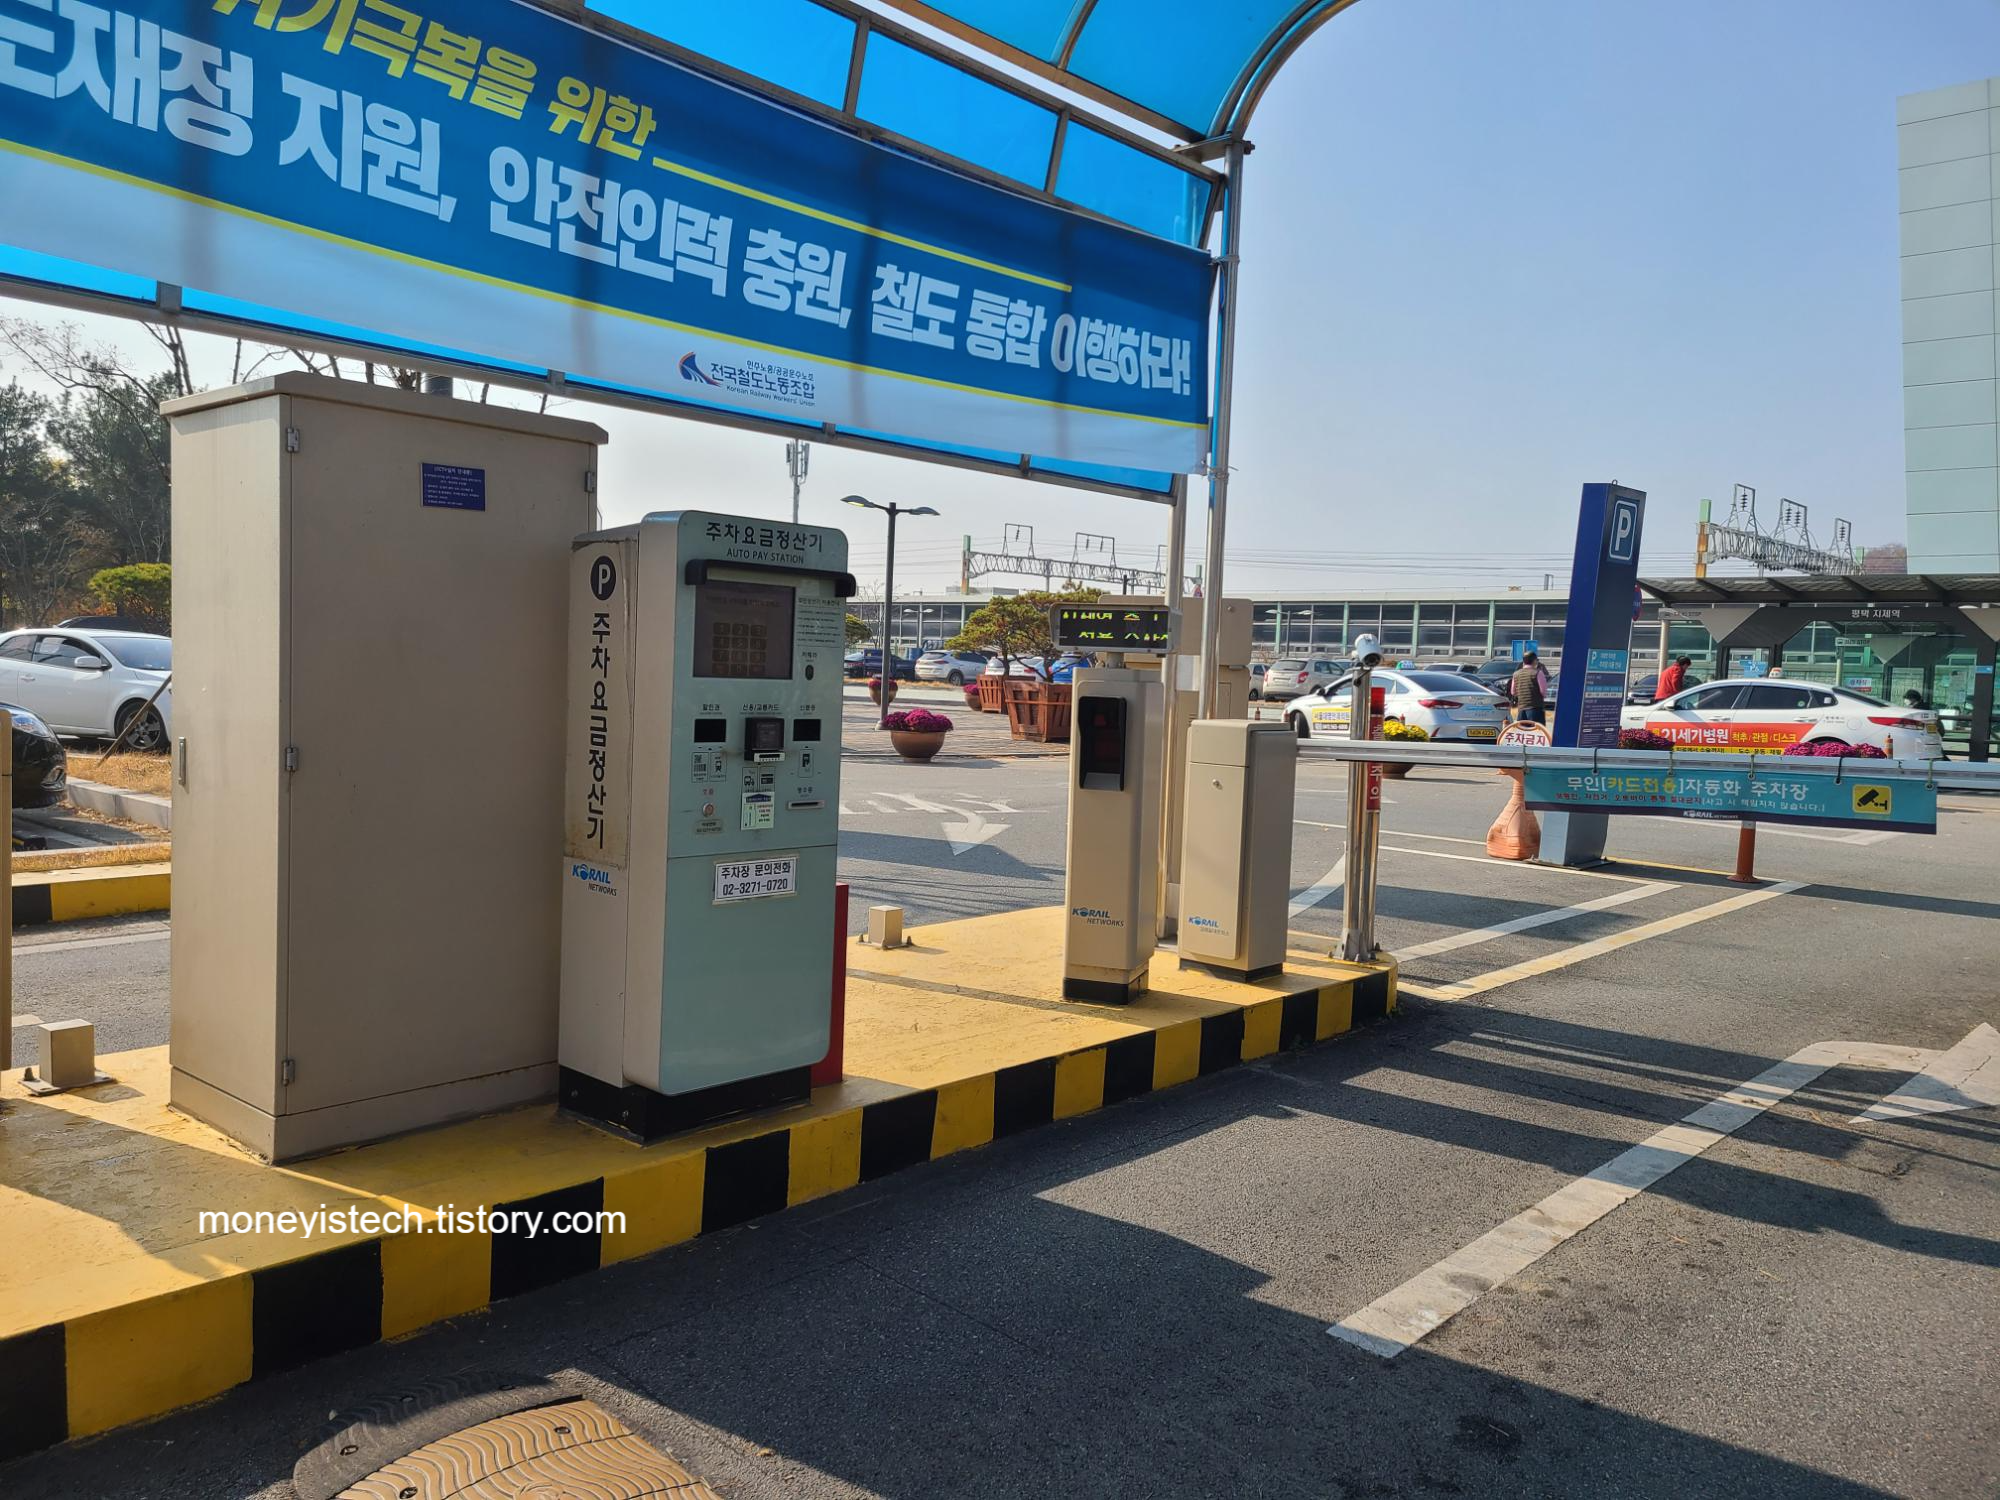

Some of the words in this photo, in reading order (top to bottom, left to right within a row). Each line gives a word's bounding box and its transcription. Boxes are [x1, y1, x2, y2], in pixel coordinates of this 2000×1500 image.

[547, 76, 656, 161] 위한
[279, 73, 456, 222] 지원,
[488, 146, 734, 297] 안전인력
[743, 227, 852, 329] 충원,
[872, 264, 961, 350] 철도
[966, 289, 1048, 368] 통합
[1051, 312, 1192, 396] 이행하라!
[711, 362, 816, 399] 전국철도노동조합
[727, 385, 749, 395] Korean
[750, 390, 772, 401] Railway
[800, 398, 816, 406] Union
[706, 522, 822, 552] 주차요금정산기
[1615, 508, 1631, 551] P
[726, 548, 750, 559] AUTO
[752, 550, 768, 561] PAY
[771, 552, 804, 564] STATION
[587, 612, 611, 850] 주차요금정산기
[1751, 781, 1809, 801] 주차장
[1683, 810, 1713, 819] KORAIL
[572, 863, 611, 885] KORAIL
[721, 865, 750, 879] 주차장
[754, 862, 791, 876] 문의전화
[588, 882, 617, 897] NETWORKS
[722, 878, 788, 896] 02-3271-0720
[1072, 907, 1110, 919] KORAIL
[1087, 917, 1124, 927] NETWORKS
[1188, 916, 1219, 928] KORAIL
